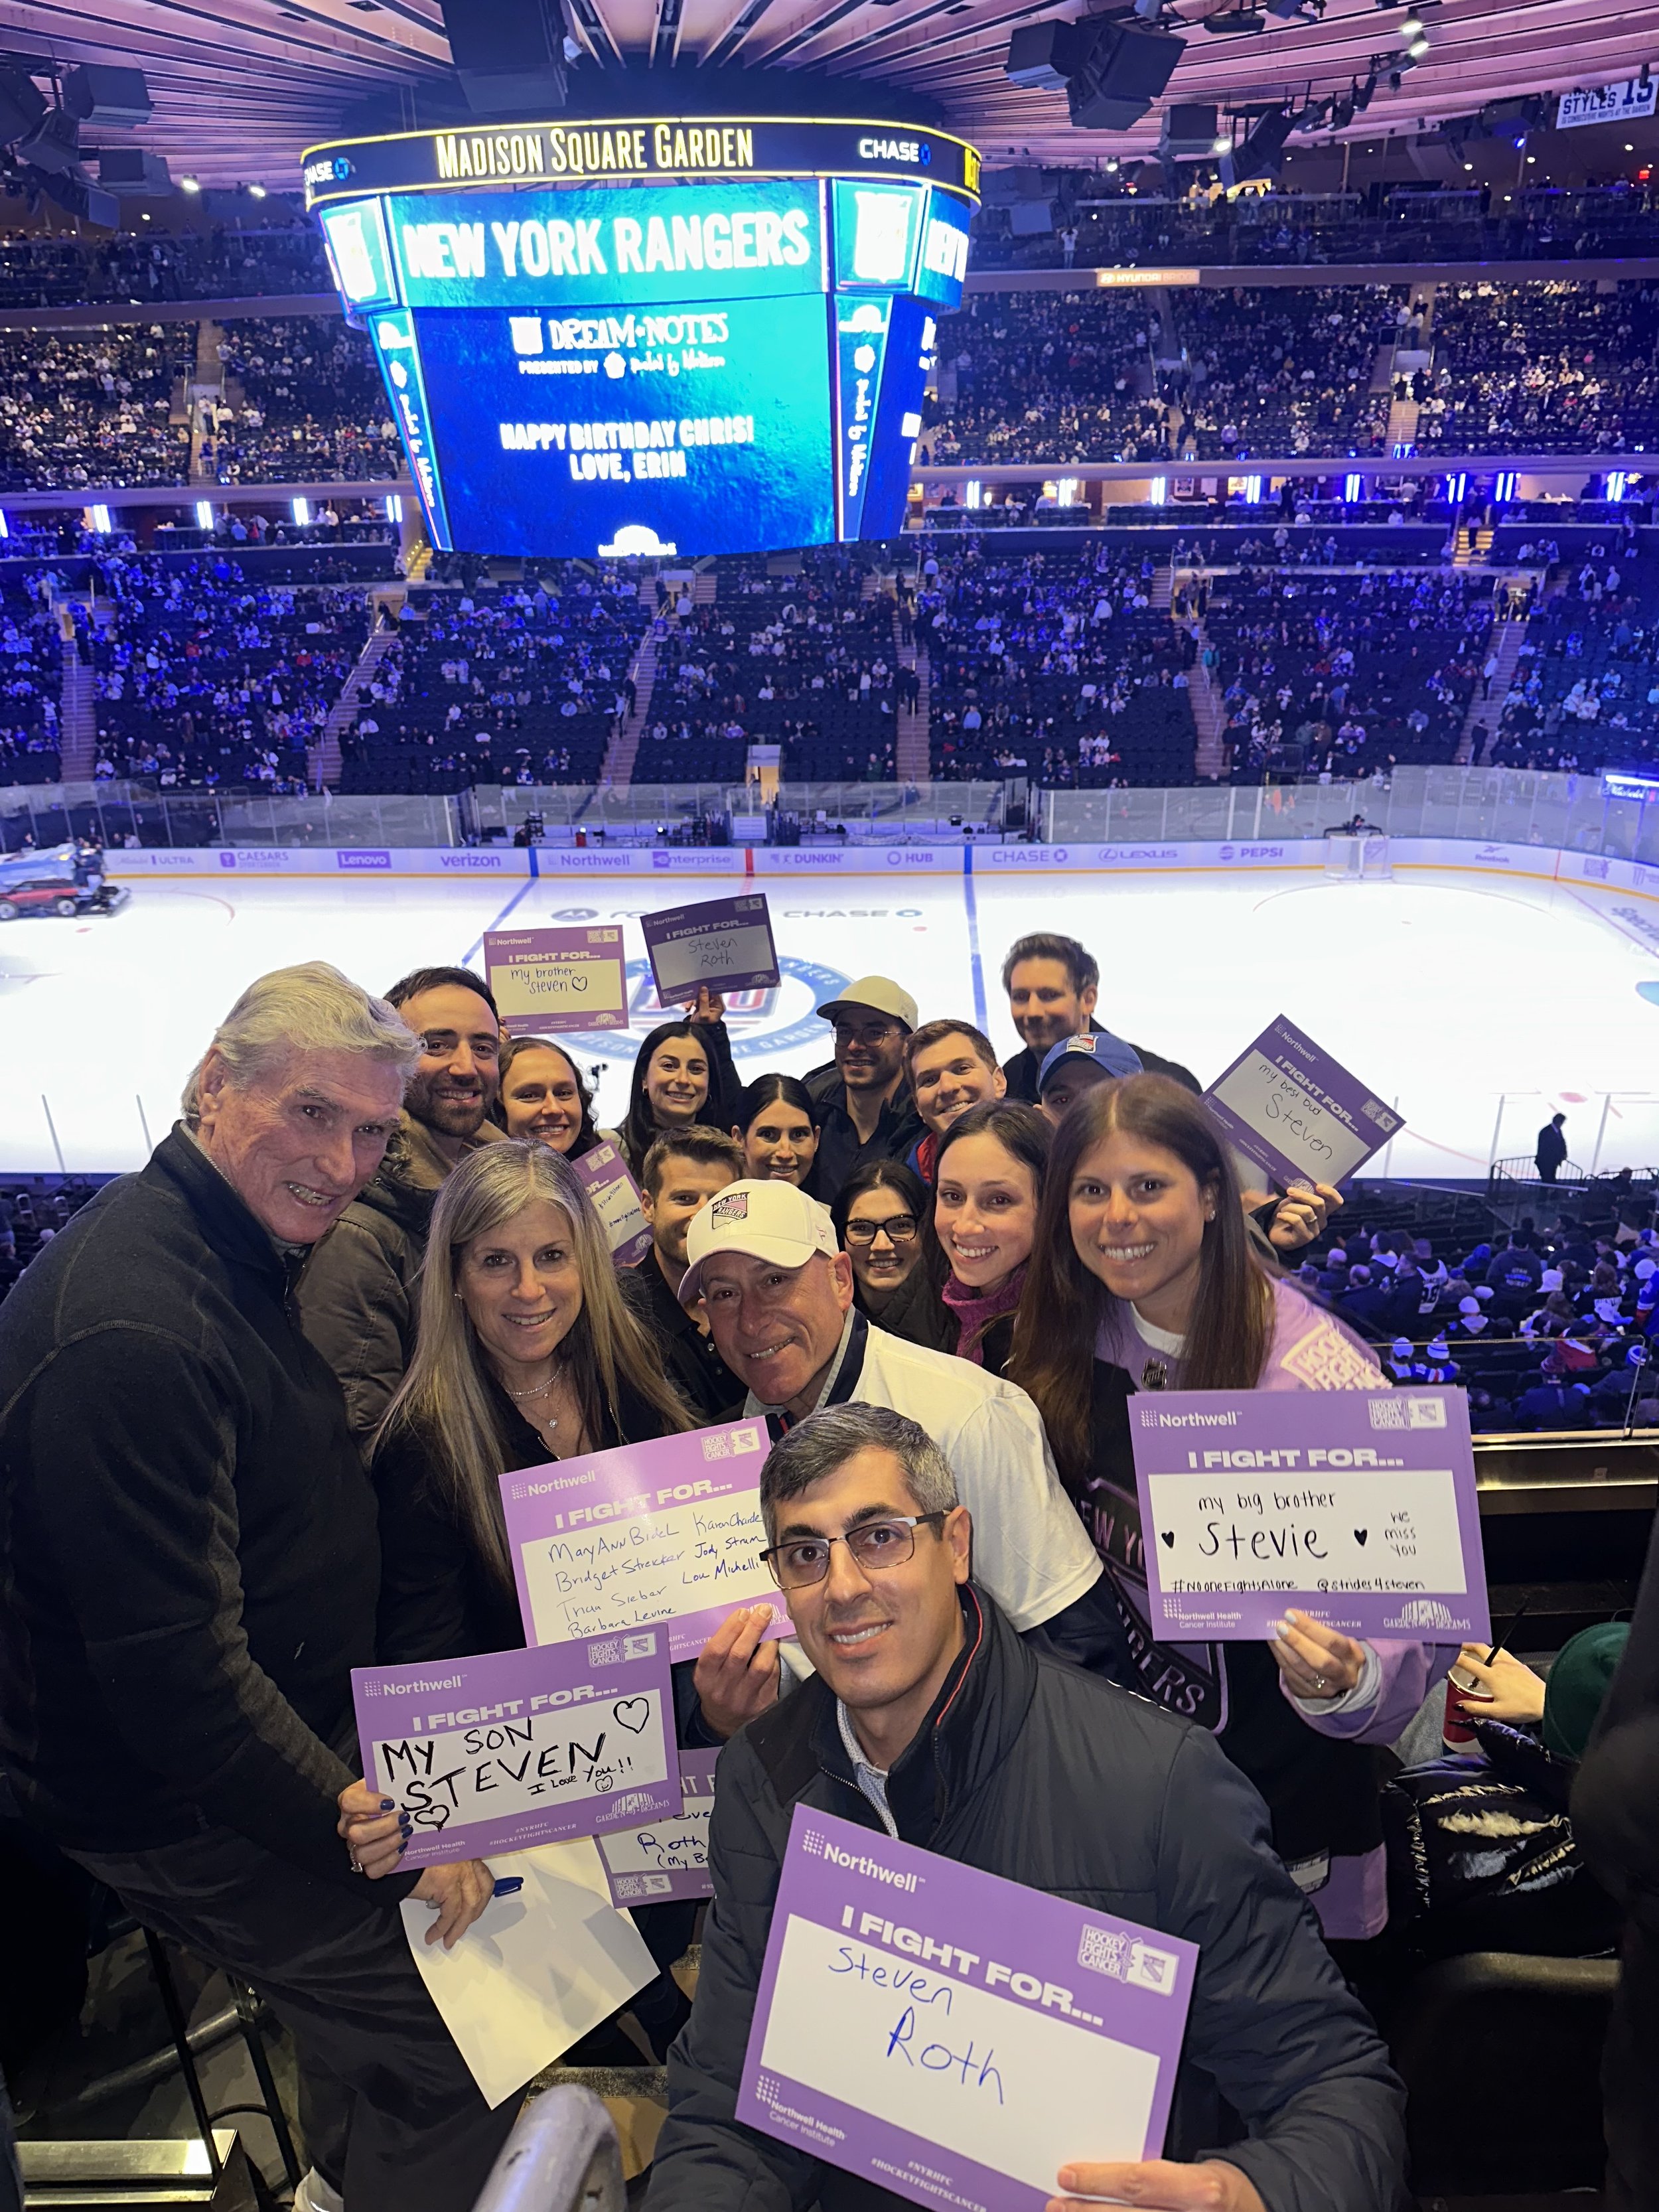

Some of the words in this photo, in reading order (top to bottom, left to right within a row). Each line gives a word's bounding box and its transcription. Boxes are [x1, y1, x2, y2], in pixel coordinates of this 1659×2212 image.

[435, 134, 544, 179] MADISON
[550, 127, 648, 174] SQUARE
[654, 124, 753, 169] GARDEN
[859, 139, 920, 162] CHASE
[403, 222, 485, 277] NEW
[491, 218, 608, 277] YORK
[614, 209, 810, 273] RANGERS
[500, 423, 566, 451] HAPPY
[569, 420, 676, 451] BIRTHDAY
[679, 415, 755, 447] CHRIS!
[569, 452, 631, 483] LOVE,
[633, 450, 687, 479] ERIN
[237, 851, 289, 861] CAESARS
[340, 853, 388, 865] Lenovo
[440, 853, 502, 867] verizon
[561, 854, 630, 866] Northwell
[654, 853, 731, 866] enterprise
[794, 853, 844, 864] DUNKIN'
[905, 853, 934, 863] HUB
[992, 850, 1050, 863] CHASE
[1119, 849, 1178, 859] LEXUS
[1240, 847, 1284, 858] PEPSI
[654, 914, 685, 926] Northwell
[782, 909, 889, 919] CHASE
[672, 924, 711, 938] FIGHT
[497, 936, 532, 946] Northwell
[688, 937, 738, 954] Steven
[516, 953, 558, 962] FIGHT
[561, 951, 601, 960] FOR...
[700, 950, 735, 968] Roth
[536, 966, 576, 978] brother
[1281, 1031, 1316, 1063] Northwell
[1274, 1055, 1283, 1064] I
[1281, 1059, 1325, 1097] FIGHT
[1280, 1080, 1299, 1098] best
[1303, 1097, 1323, 1116] bud
[1265, 1093, 1333, 1160] Steven
[713, 1199, 727, 1210] NEW
[717, 1207, 745, 1218] RANGERS
[1159, 1411, 1237, 1428] Northwell
[703, 1435, 727, 1446] HOCKEY
[704, 1442, 727, 1453] FIGHTS
[706, 1449, 731, 1460] CANCER
[1188, 1451, 1198, 1469] I
[1203, 1449, 1301, 1469] FIGHT
[1307, 1448, 1404, 1467] FOR...
[528, 1470, 596, 1497] Northwell
[555, 1514, 563, 1529] I
[569, 1493, 652, 1526] FIGHT
[656, 1479, 733, 1505] FOR...
[1198, 1496, 1225, 1515] my
[1238, 1493, 1263, 1515] big
[1273, 1490, 1336, 1511] brother
[1198, 1522, 1329, 1561] Stevie
[555, 1564, 619, 1593] Bridget
[695, 1542, 718, 1560] Jody
[682, 1571, 710, 1584] Lou
[567, 1617, 631, 1639] Barbara
[634, 1607, 677, 1623] Levine
[1178, 1612, 1215, 1621] Northwell
[1217, 1612, 1242, 1621] Health
[668, 1633, 686, 1643] RHFC
[591, 1641, 618, 1653] HOCKEY
[591, 1648, 616, 1659] FIGHTS
[592, 1655, 620, 1666] CANCER
[383, 1675, 463, 1696] Northwell
[412, 1717, 423, 1732] I
[428, 1699, 524, 1730] FIGHT
[530, 1684, 618, 1712] FOR...
[381, 1739, 435, 1783] MY
[464, 1716, 534, 1755] SON
[399, 1732, 607, 1814] STEVEN
[527, 1783, 546, 1796] I
[595, 1810, 626, 1824] GARDEN
[489, 1823, 577, 1846] #HOCKEYFIGHTSCANCER
[515, 1821, 550, 1834] #NYRHFC
[404, 1842, 441, 1857] Northwell
[441, 1840, 466, 1850] Health
[637, 1832, 707, 1855] Roth
[405, 1852, 431, 1862] Cancer
[824, 1842, 917, 1894] Northwell
[1086, 1928, 1125, 1951] HOCKEY
[1084, 1940, 1118, 1962] FIGHTS
[841, 1905, 855, 1929] I
[859, 1912, 979, 1976] FIGHT
[985, 1960, 1104, 2028] FOR...
[1082, 1951, 1121, 1976] CANCER
[828, 1946, 953, 2016] Steven
[887, 2006, 1004, 2105] Roth
[770, 2100, 816, 2128] Northwell
[816, 2118, 846, 2140] Health
[769, 2110, 800, 2130] Cancer
[800, 2124, 836, 2148] Institute
[907, 2160, 954, 2187] #NYRHFC
[871, 2156, 993, 2212] #HOCKEYFIGHTSCANCER
